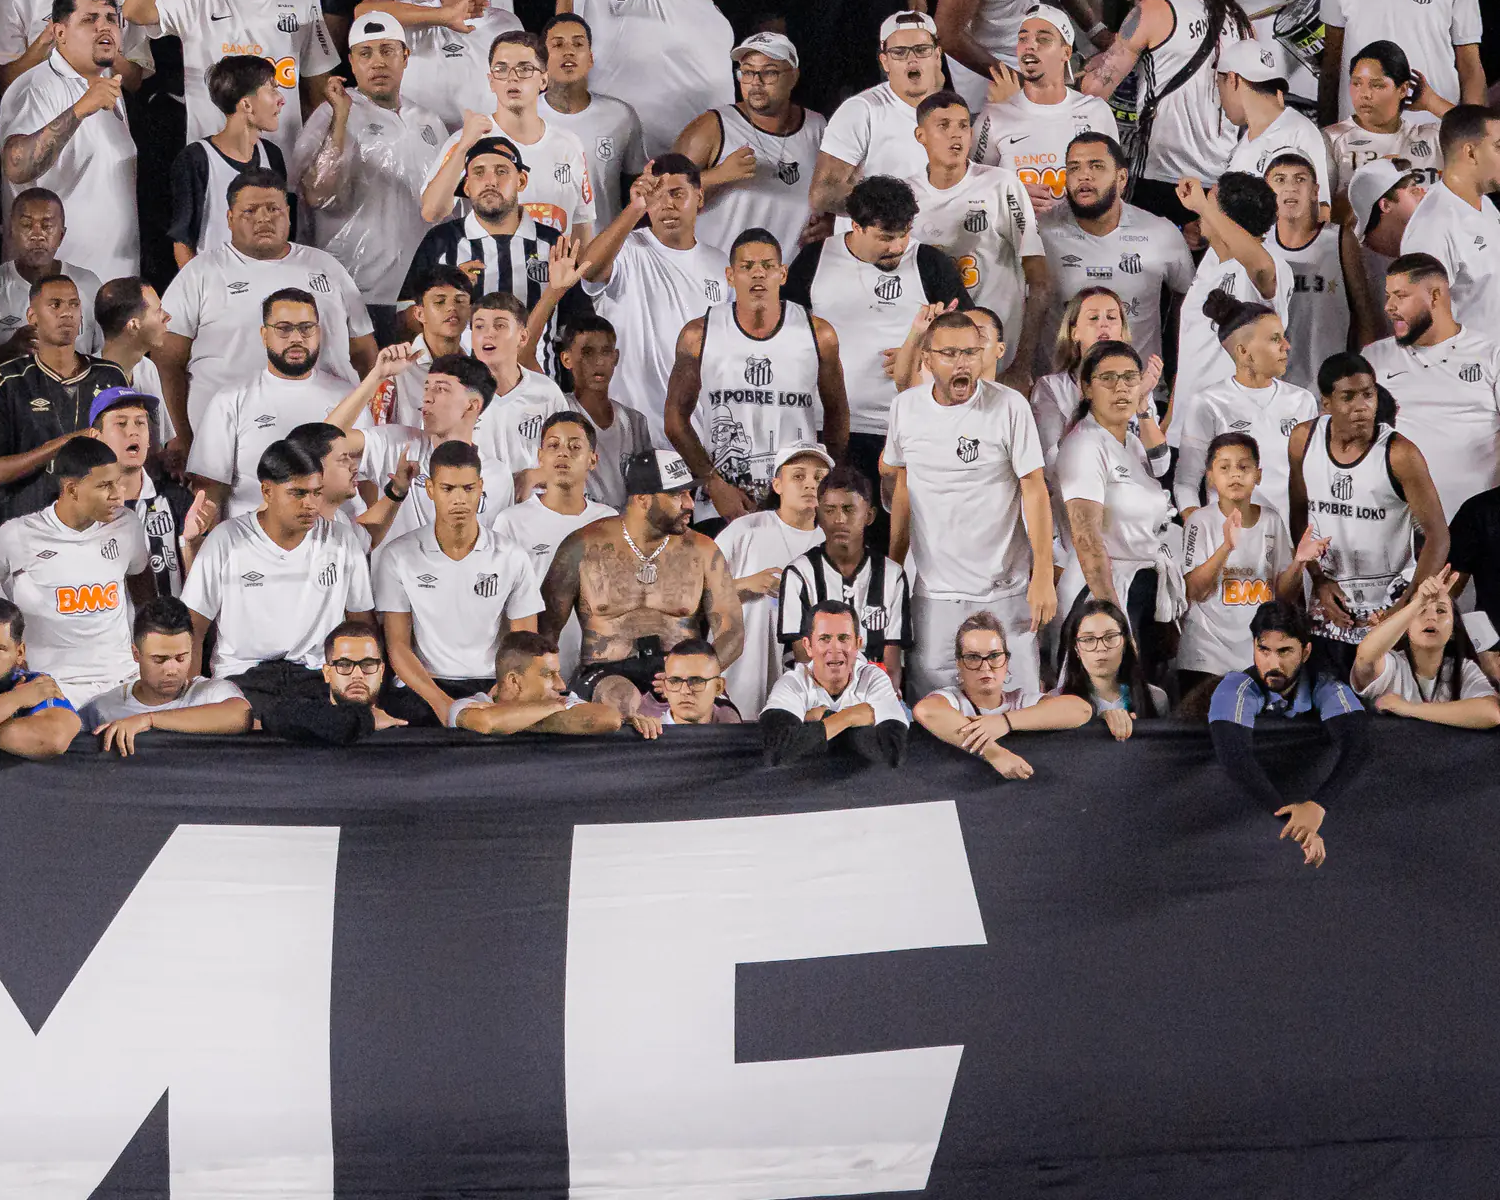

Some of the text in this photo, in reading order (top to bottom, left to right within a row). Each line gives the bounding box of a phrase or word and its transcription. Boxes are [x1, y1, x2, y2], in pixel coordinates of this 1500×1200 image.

[222, 43, 262, 55] BANCO
[1014, 154, 1056, 166] BANCO
[1119, 235, 1149, 243] HEBRON
[723, 389, 773, 405] POBRE
[779, 392, 813, 408] LOKO
[1318, 500, 1353, 518] POBRE
[1355, 504, 1386, 520] LOKO
[1185, 523, 1199, 568] NETSHOES
[56, 582, 120, 613] BMG
